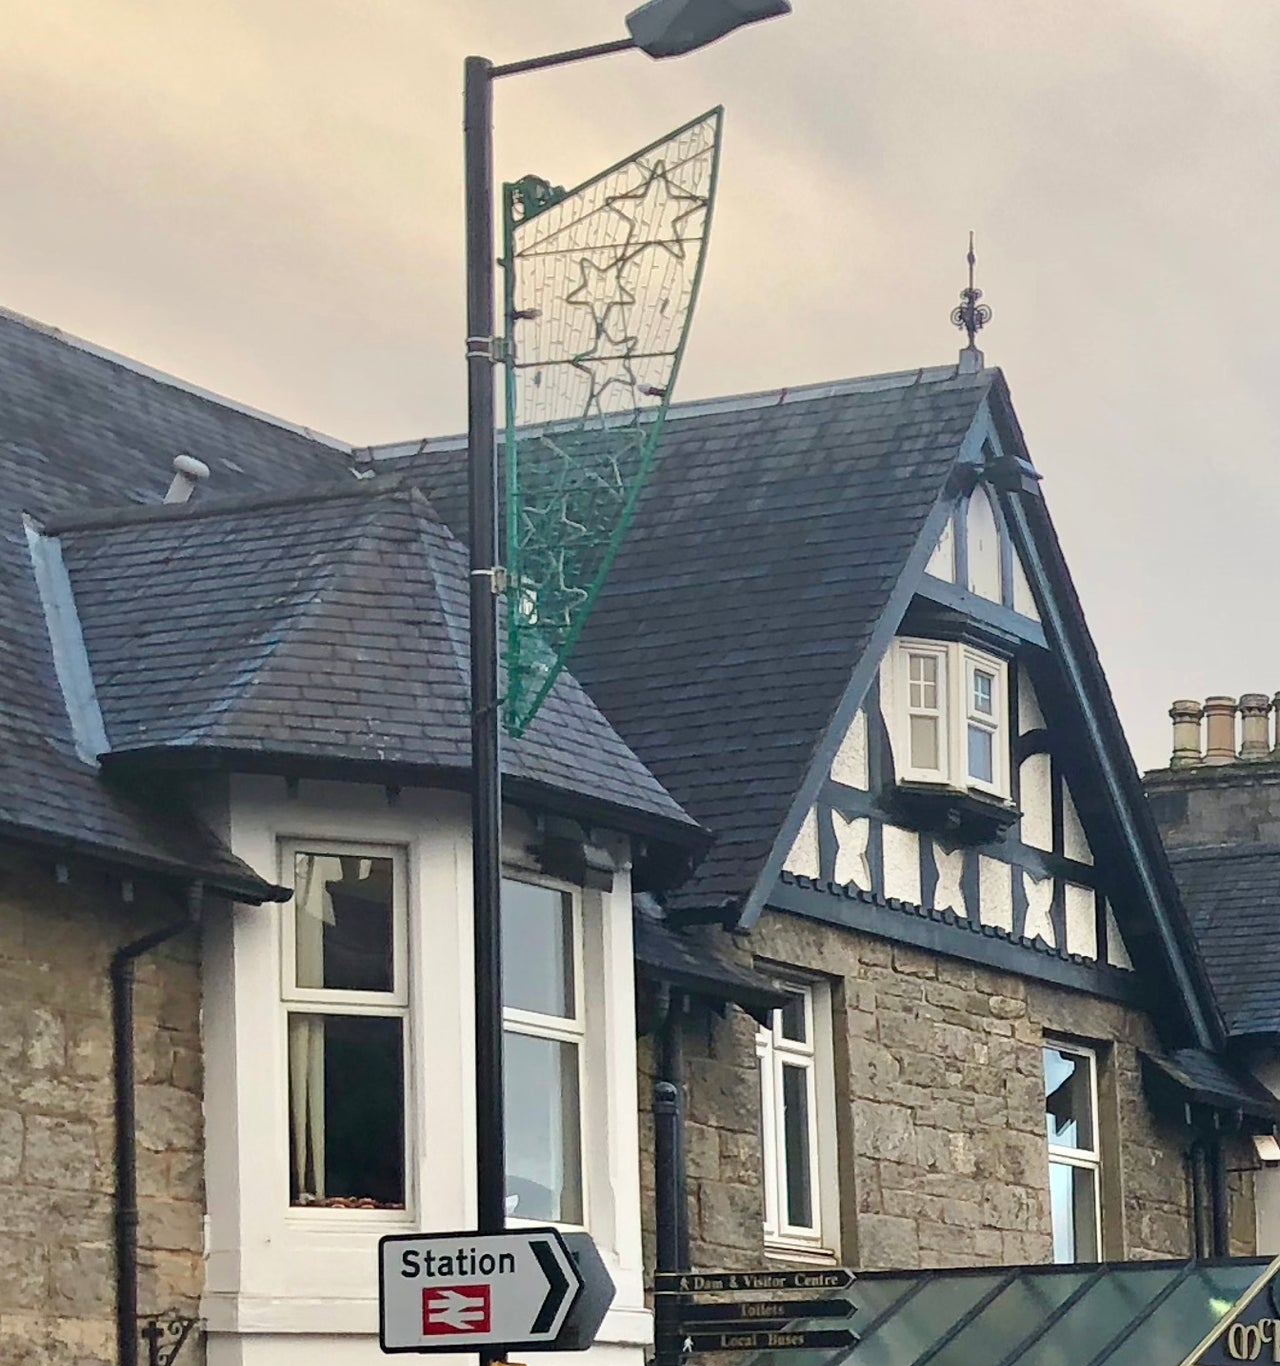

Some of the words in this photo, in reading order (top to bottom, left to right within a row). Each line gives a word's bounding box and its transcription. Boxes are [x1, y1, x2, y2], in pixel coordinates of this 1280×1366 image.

[400, 1247, 516, 1279] Station
[694, 1275, 724, 1290] Dam
[728, 1273, 739, 1288] &
[743, 1273, 787, 1288] Visitor
[794, 1273, 839, 1287] Centre
[721, 1333, 757, 1348] Local
[768, 1332, 805, 1346] Buses
